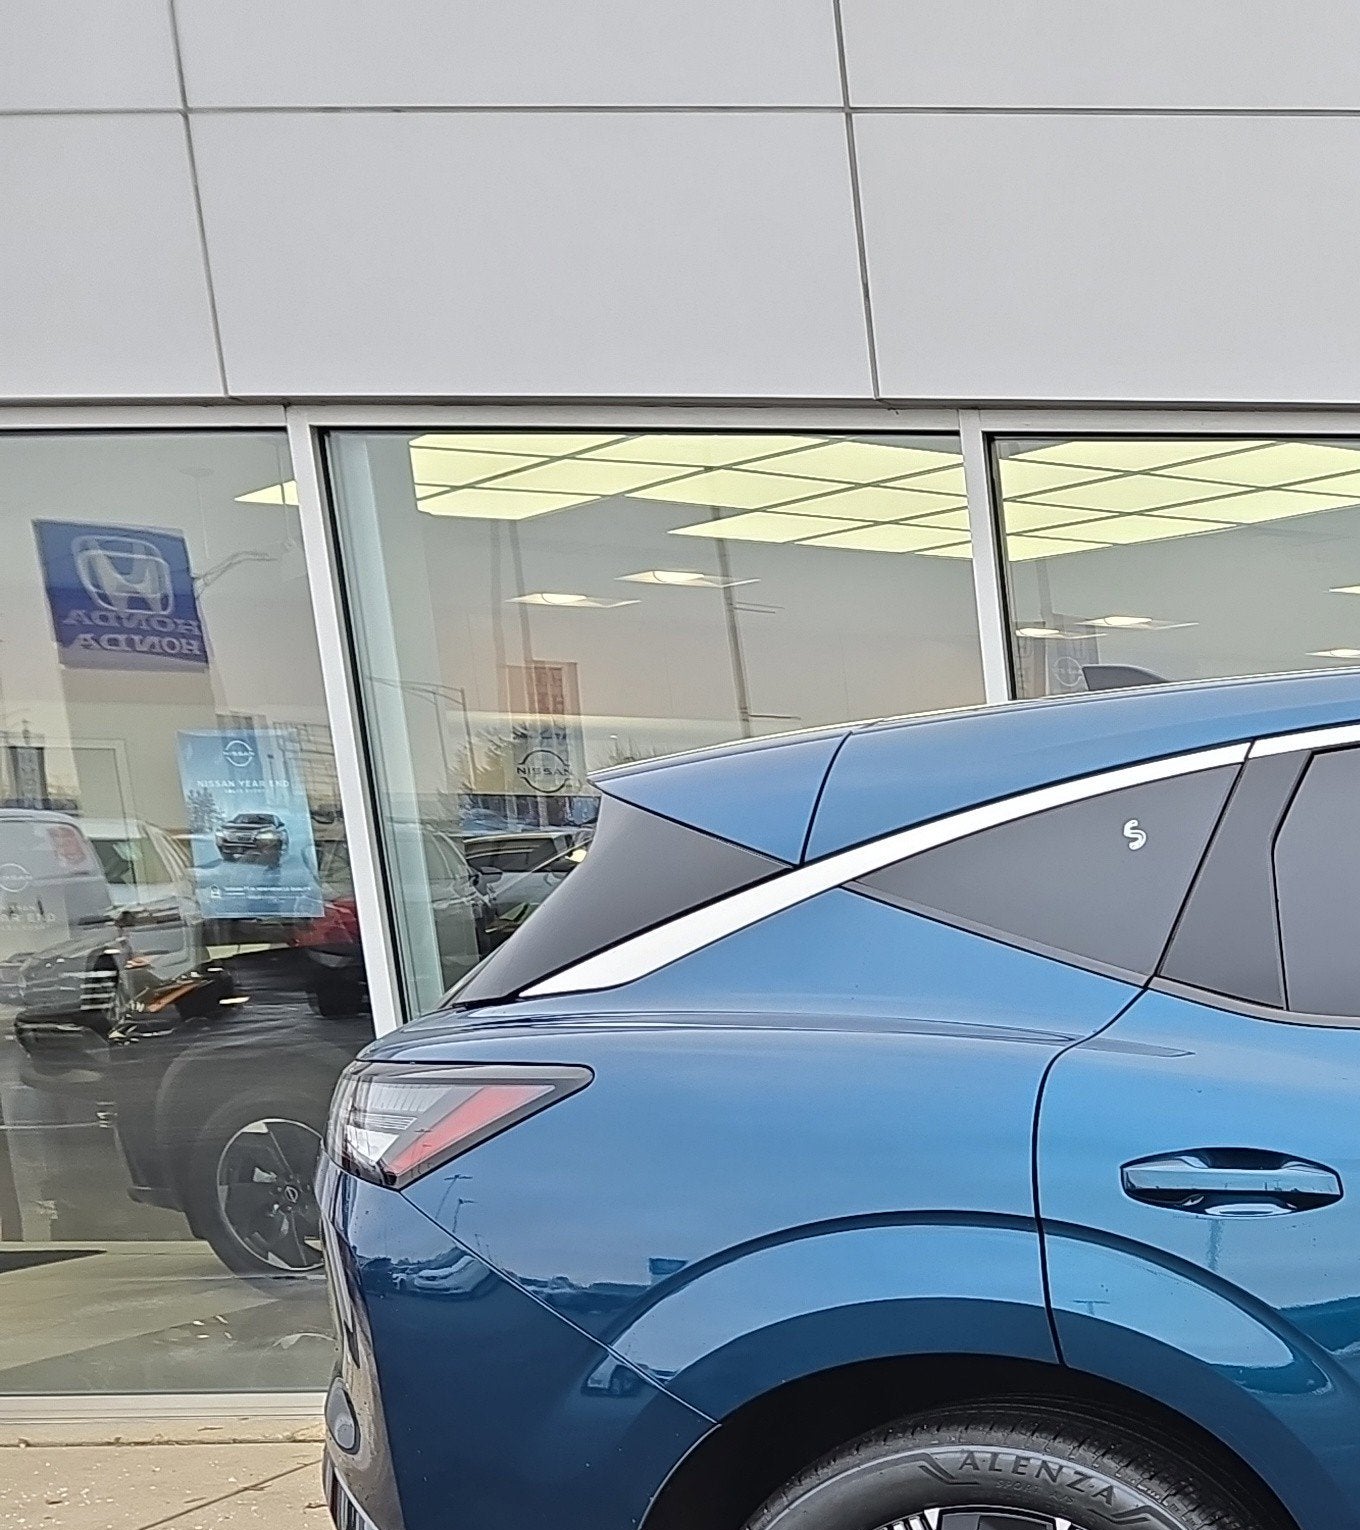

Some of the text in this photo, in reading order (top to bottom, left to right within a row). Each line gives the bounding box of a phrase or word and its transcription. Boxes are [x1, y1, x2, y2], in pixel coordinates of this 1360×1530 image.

[516, 766, 570, 776] NISSAN
[197, 780, 236, 788] NISSAN
[239, 780, 265, 788] YEAR
[958, 1450, 1115, 1507] ALENZA
